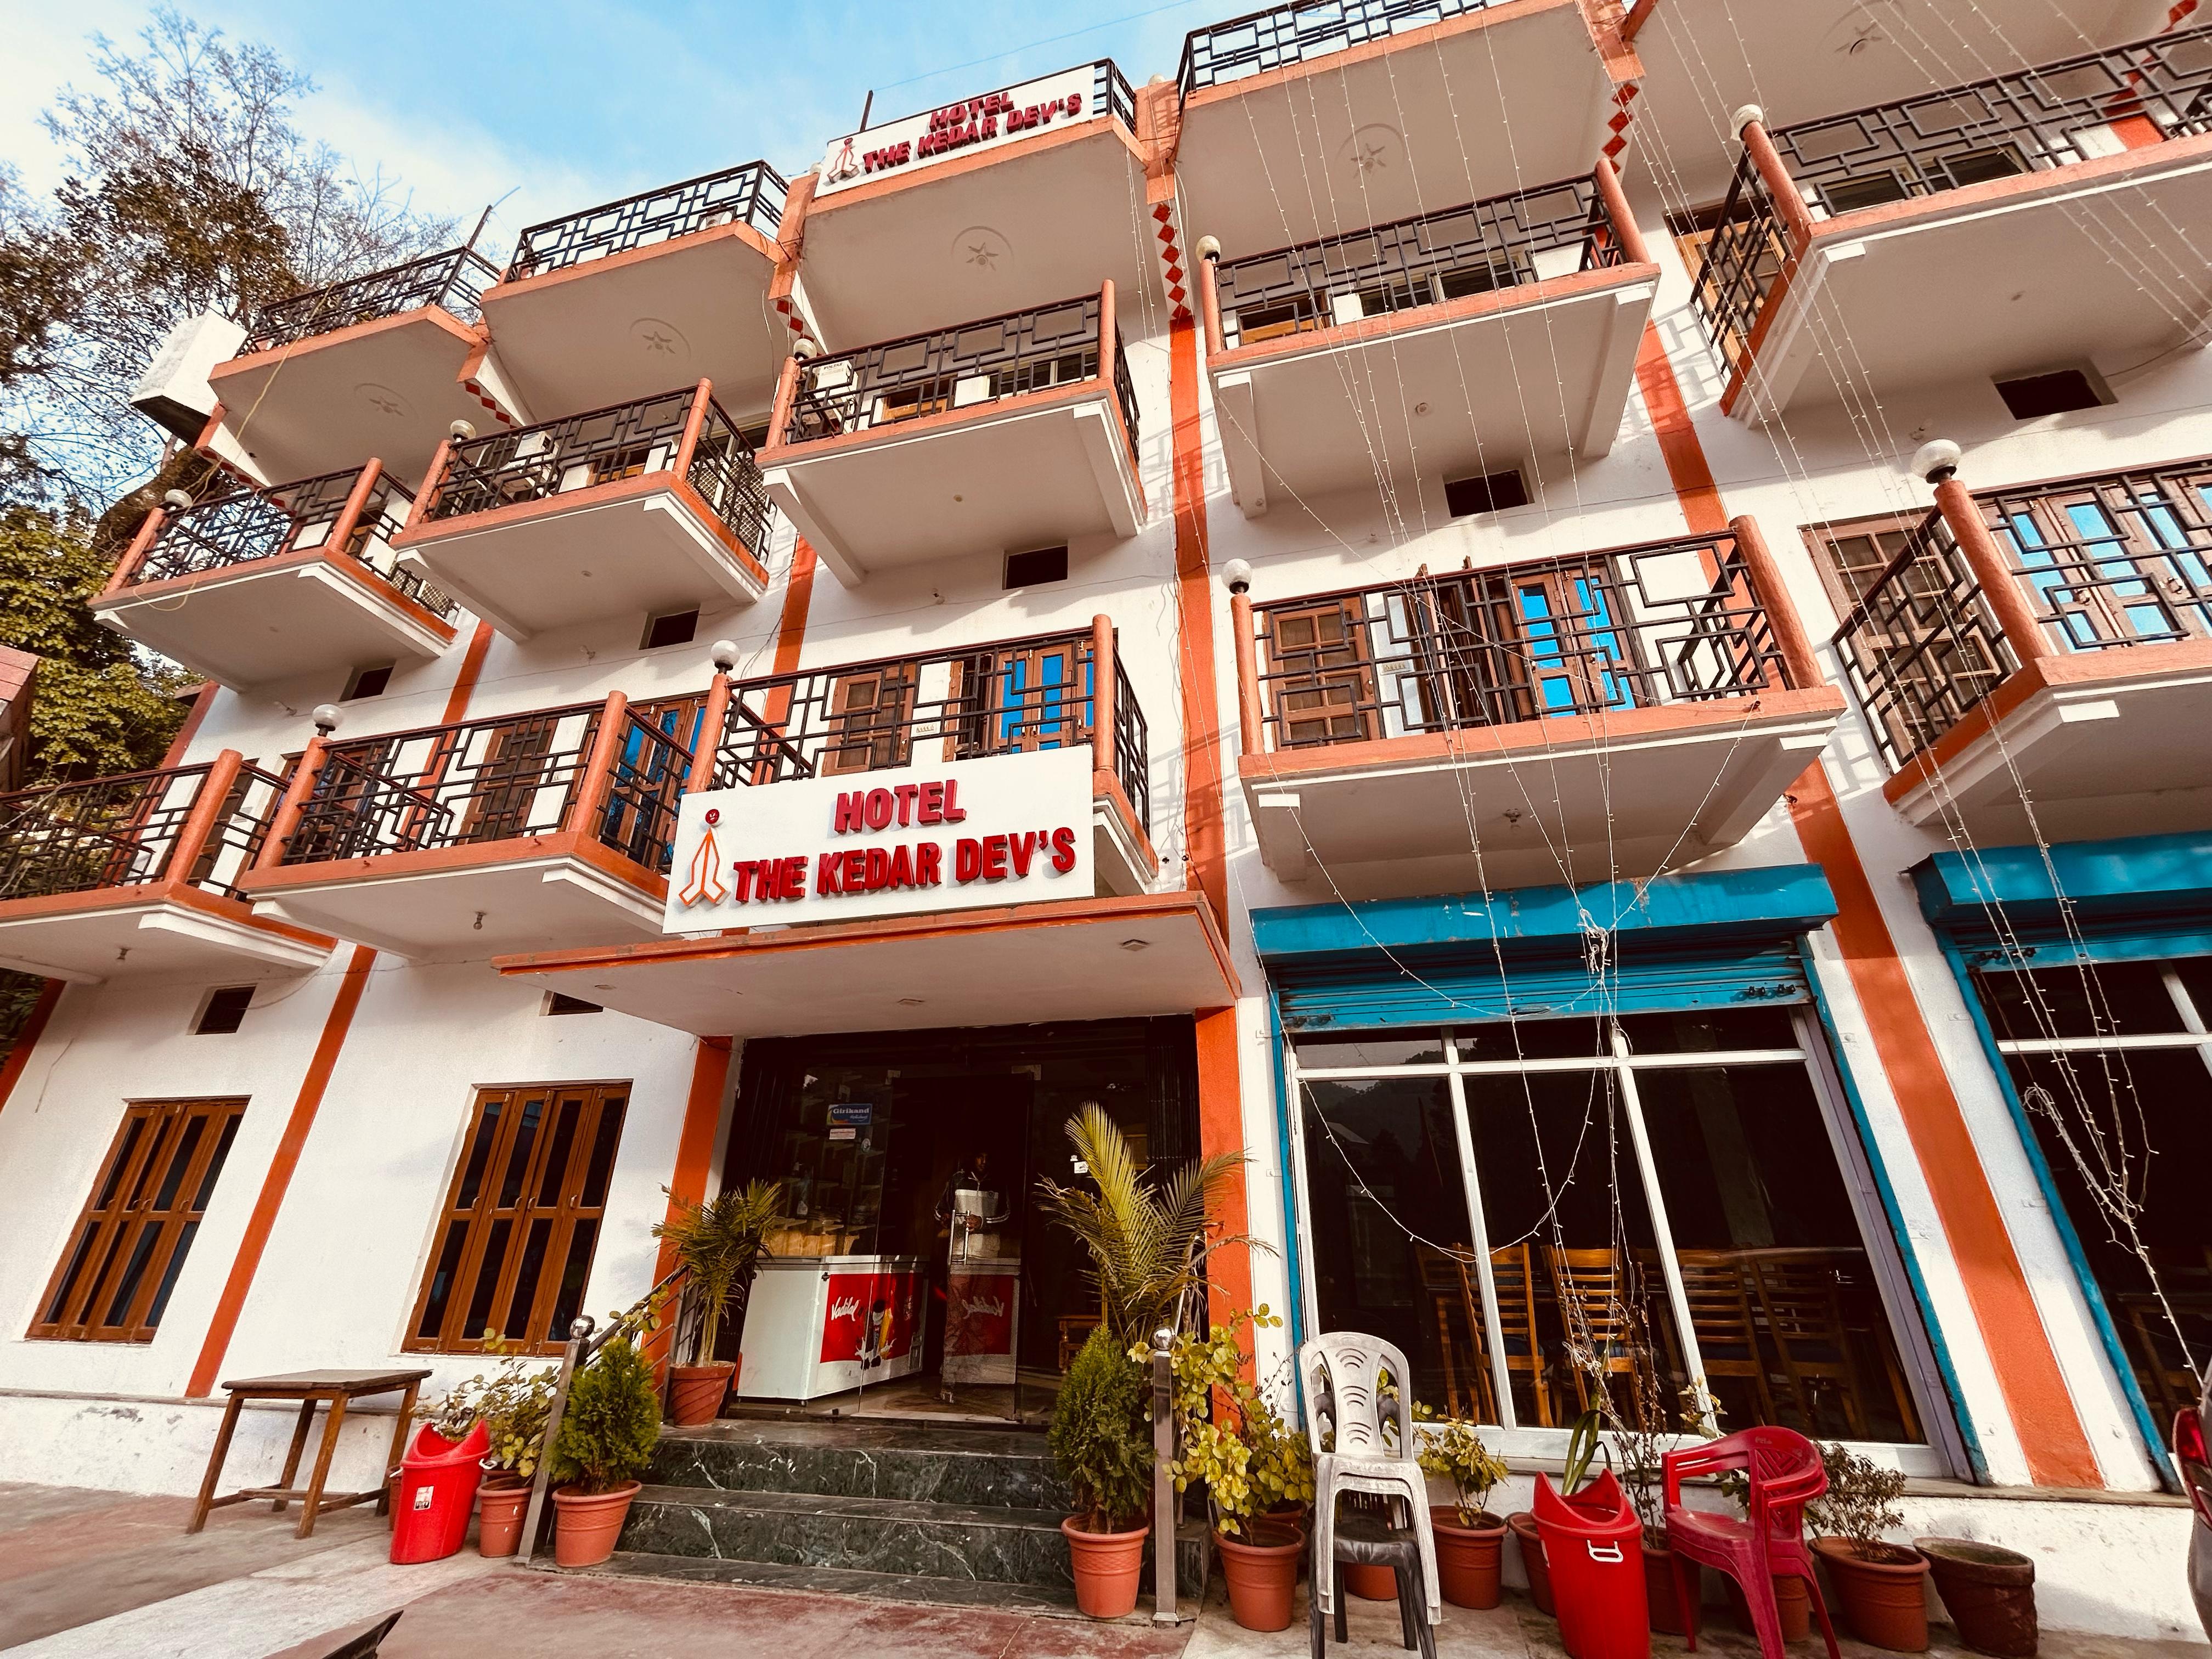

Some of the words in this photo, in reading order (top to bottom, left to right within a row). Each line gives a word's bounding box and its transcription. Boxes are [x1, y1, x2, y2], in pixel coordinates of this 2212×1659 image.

[863, 140, 911, 174] THE
[918, 116, 997, 159] KEDAR
[1006, 93, 1082, 134] DEV'S
[929, 92, 1014, 132] HOTEL
[834, 780, 967, 834] HOTEL
[733, 856, 809, 904] THE
[817, 842, 942, 896] KEDAR
[956, 827, 1076, 885] DEV'S
[831, 1296, 860, 1322] Vadilal
